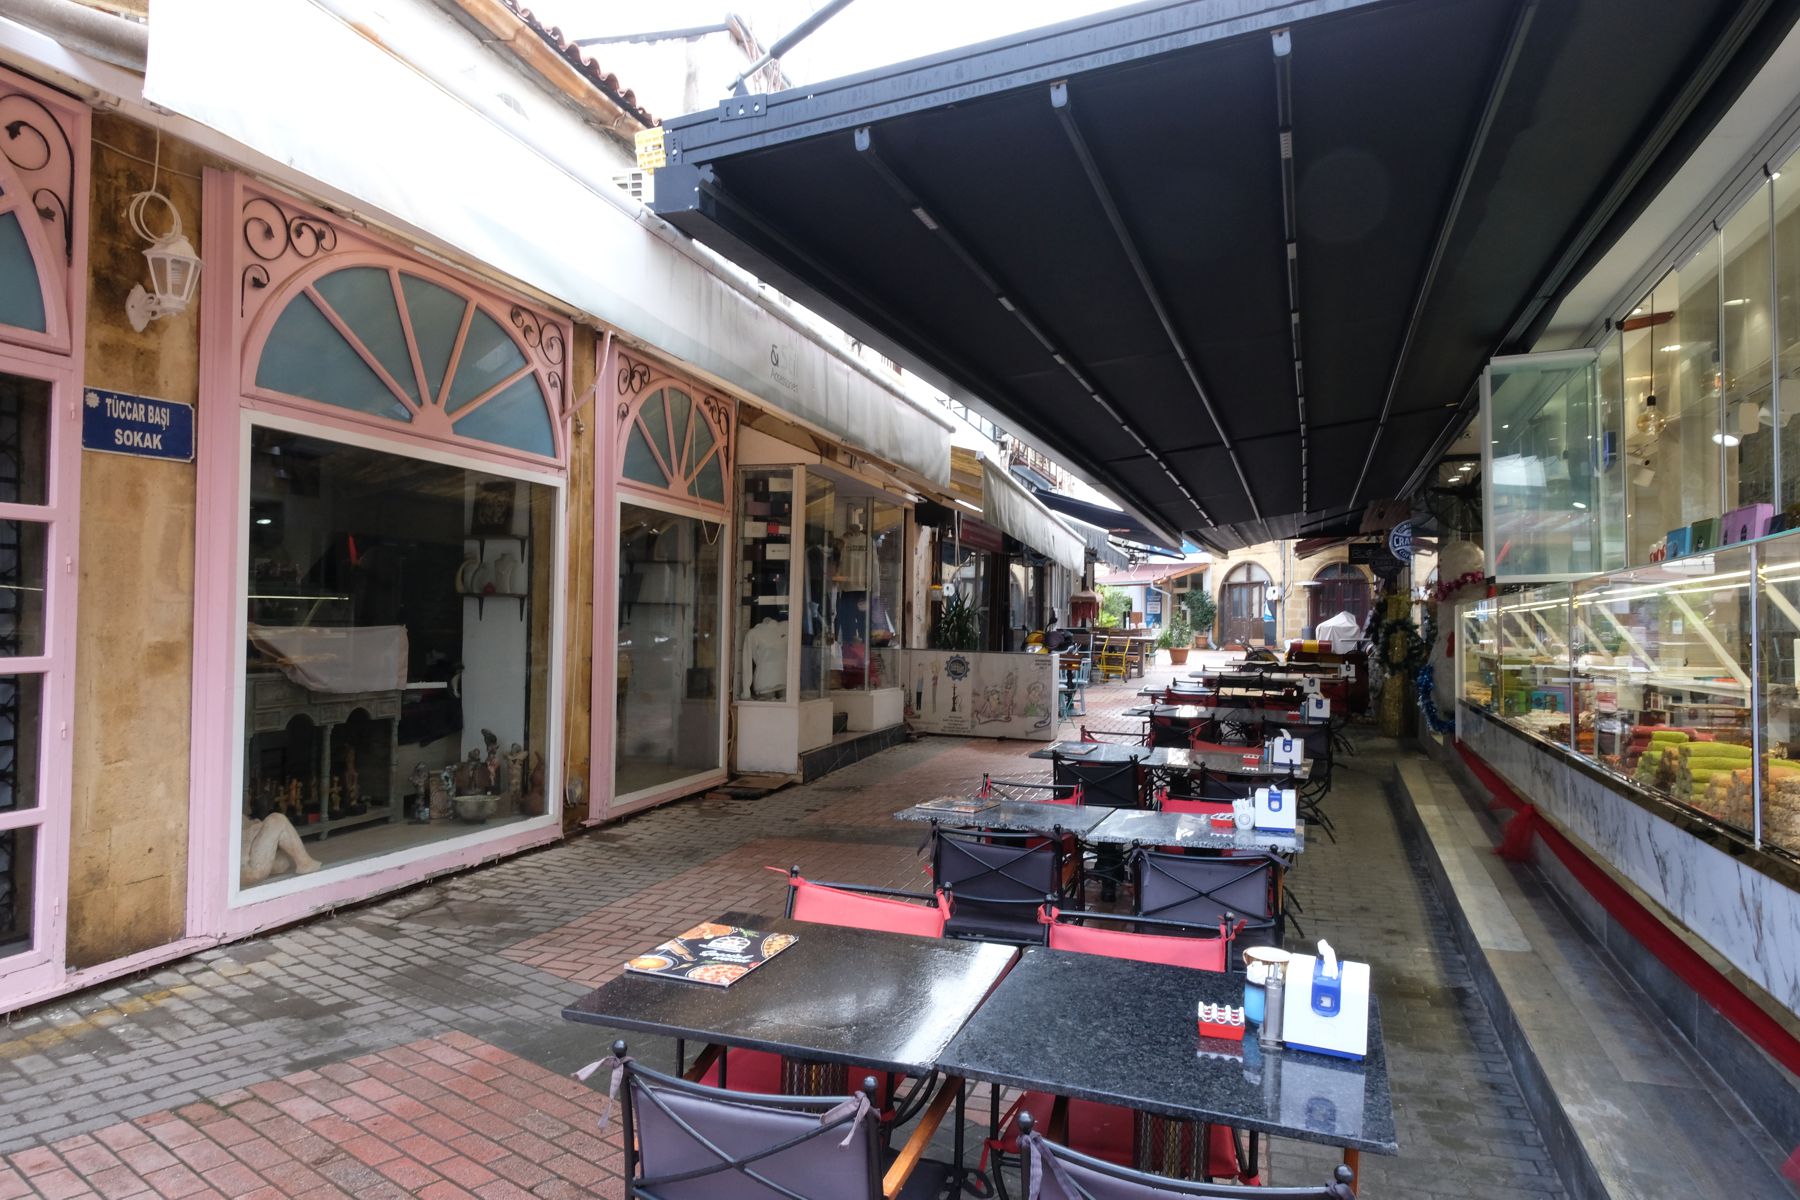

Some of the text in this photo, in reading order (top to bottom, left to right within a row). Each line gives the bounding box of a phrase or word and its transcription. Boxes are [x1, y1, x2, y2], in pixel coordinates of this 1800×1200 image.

[106, 395, 170, 430] TÜCCAR BAŞI
[115, 429, 162, 450] SOKAK
[1393, 536, 1412, 547] CRA
